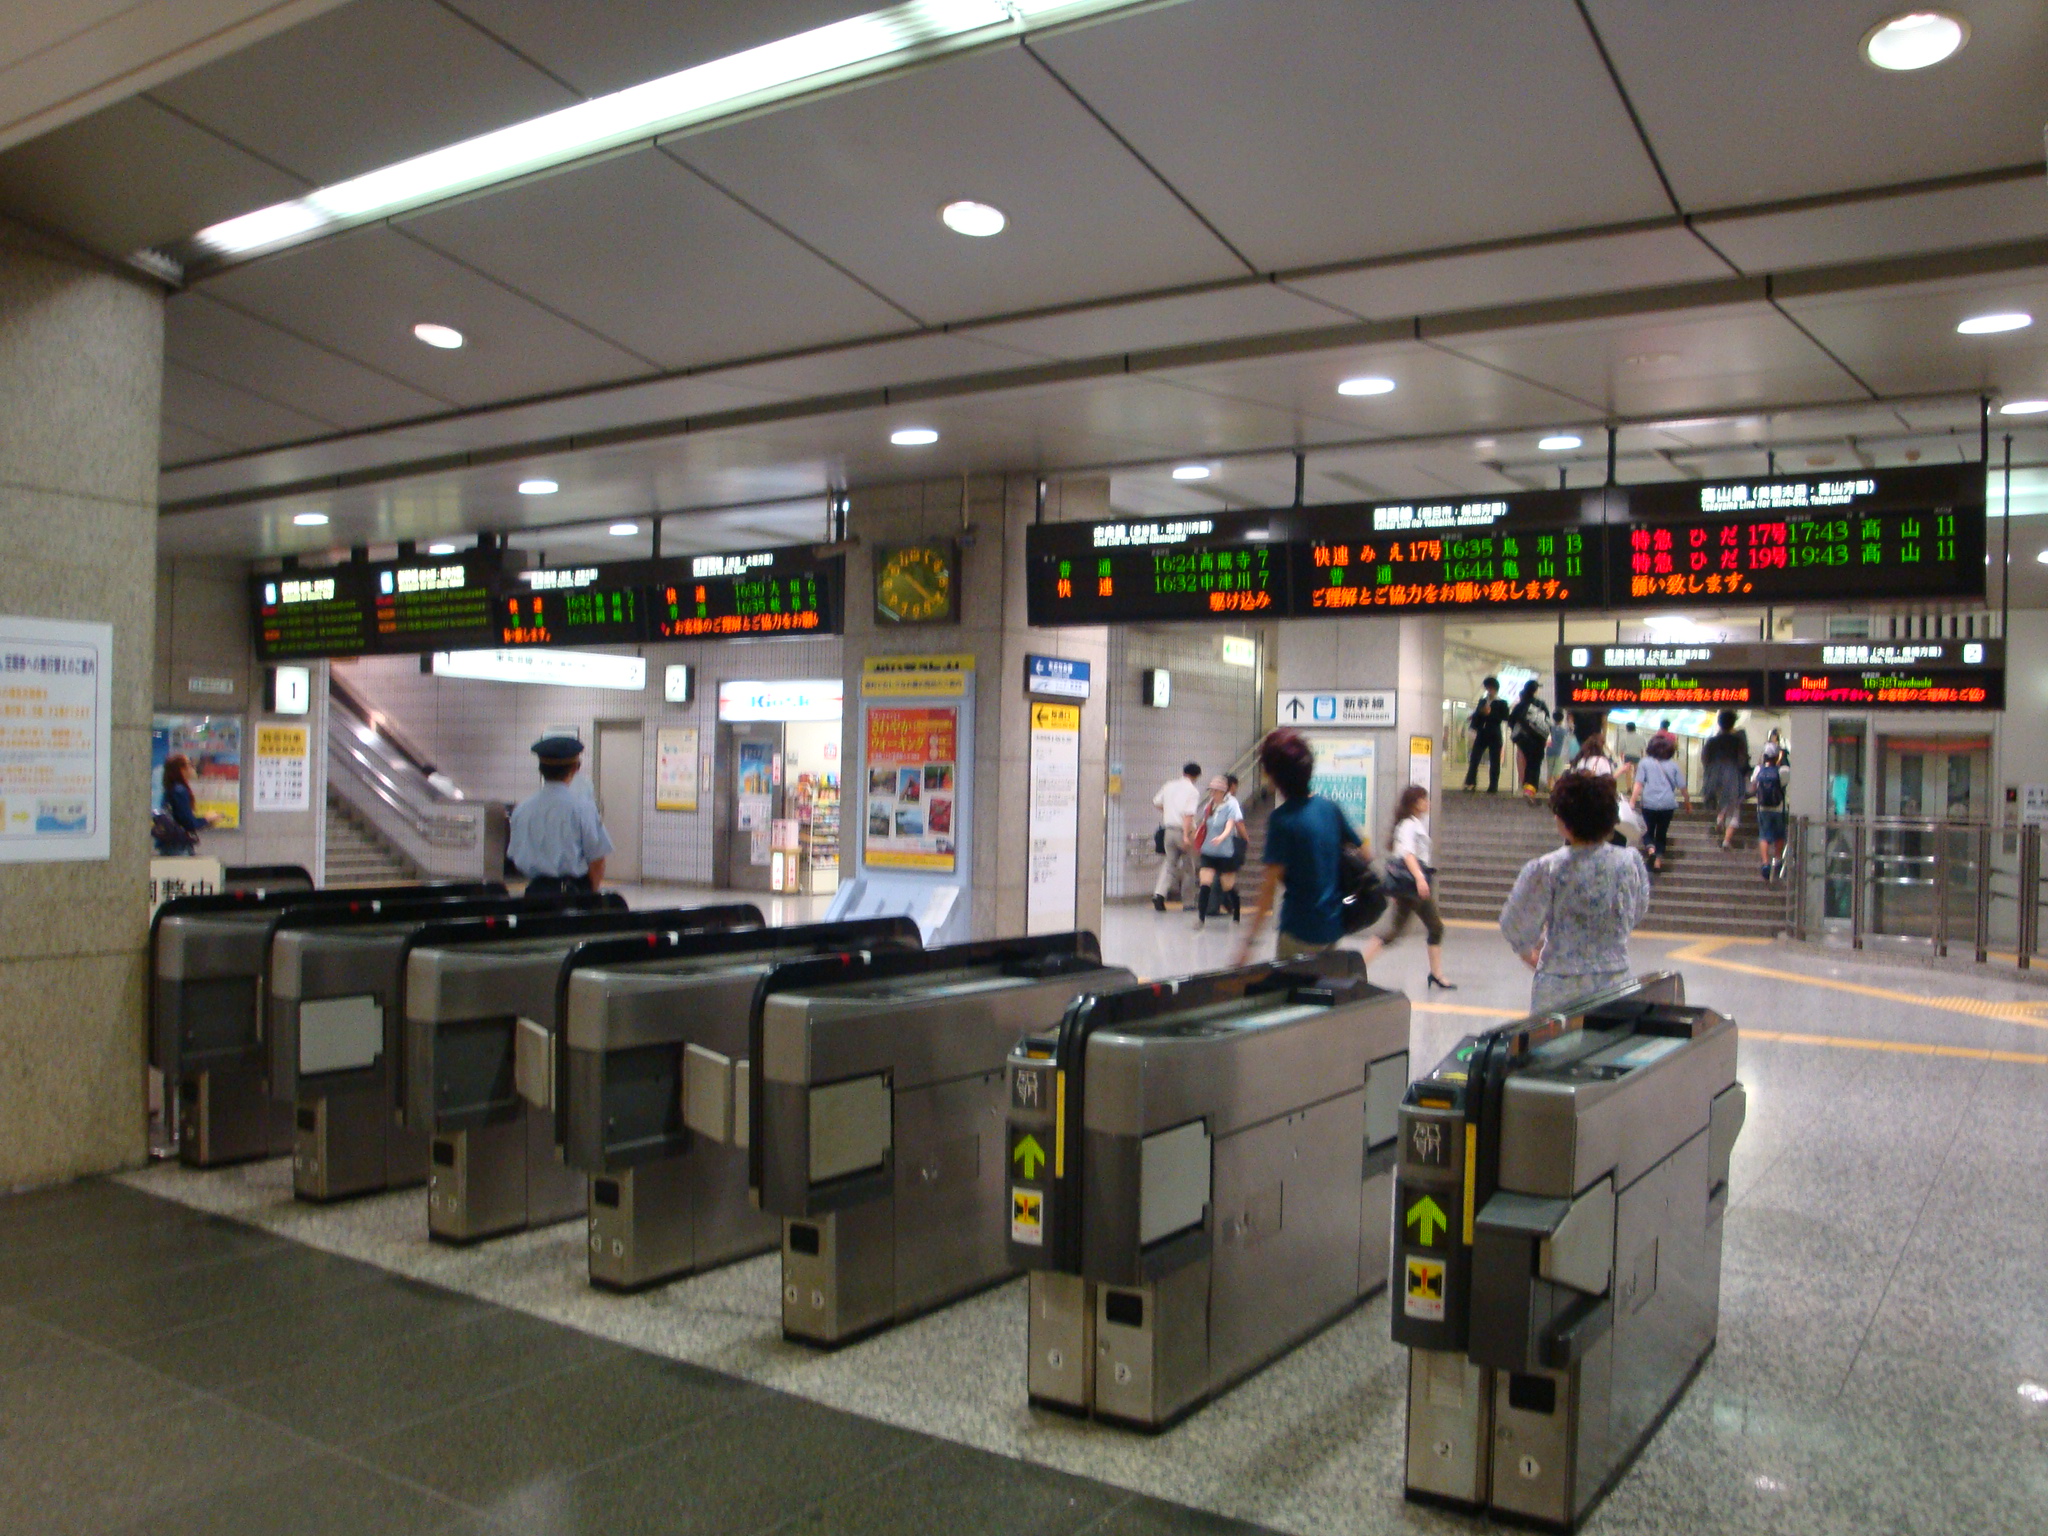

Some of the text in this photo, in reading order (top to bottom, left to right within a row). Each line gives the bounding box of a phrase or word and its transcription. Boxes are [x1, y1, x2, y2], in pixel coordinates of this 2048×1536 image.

[1788, 520, 1849, 544] 17:43
[1936, 515, 1956, 537] 11
[1443, 538, 1493, 560] 16:35
[1566, 533, 1583, 555] 13
[1788, 544, 1849, 568] 19:43
[1936, 539, 1956, 562] 11
[1154, 553, 1196, 574] 16:24
[1258, 549, 1269, 569] 7
[1443, 560, 1494, 582] 16:44
[1566, 556, 1582, 577] 11
[1154, 572, 1196, 594] 16:32
[1258, 570, 1269, 590] 7
[1342, 711, 1390, 721] Shinkansen
[1343, 696, 1385, 711] 新幹線
